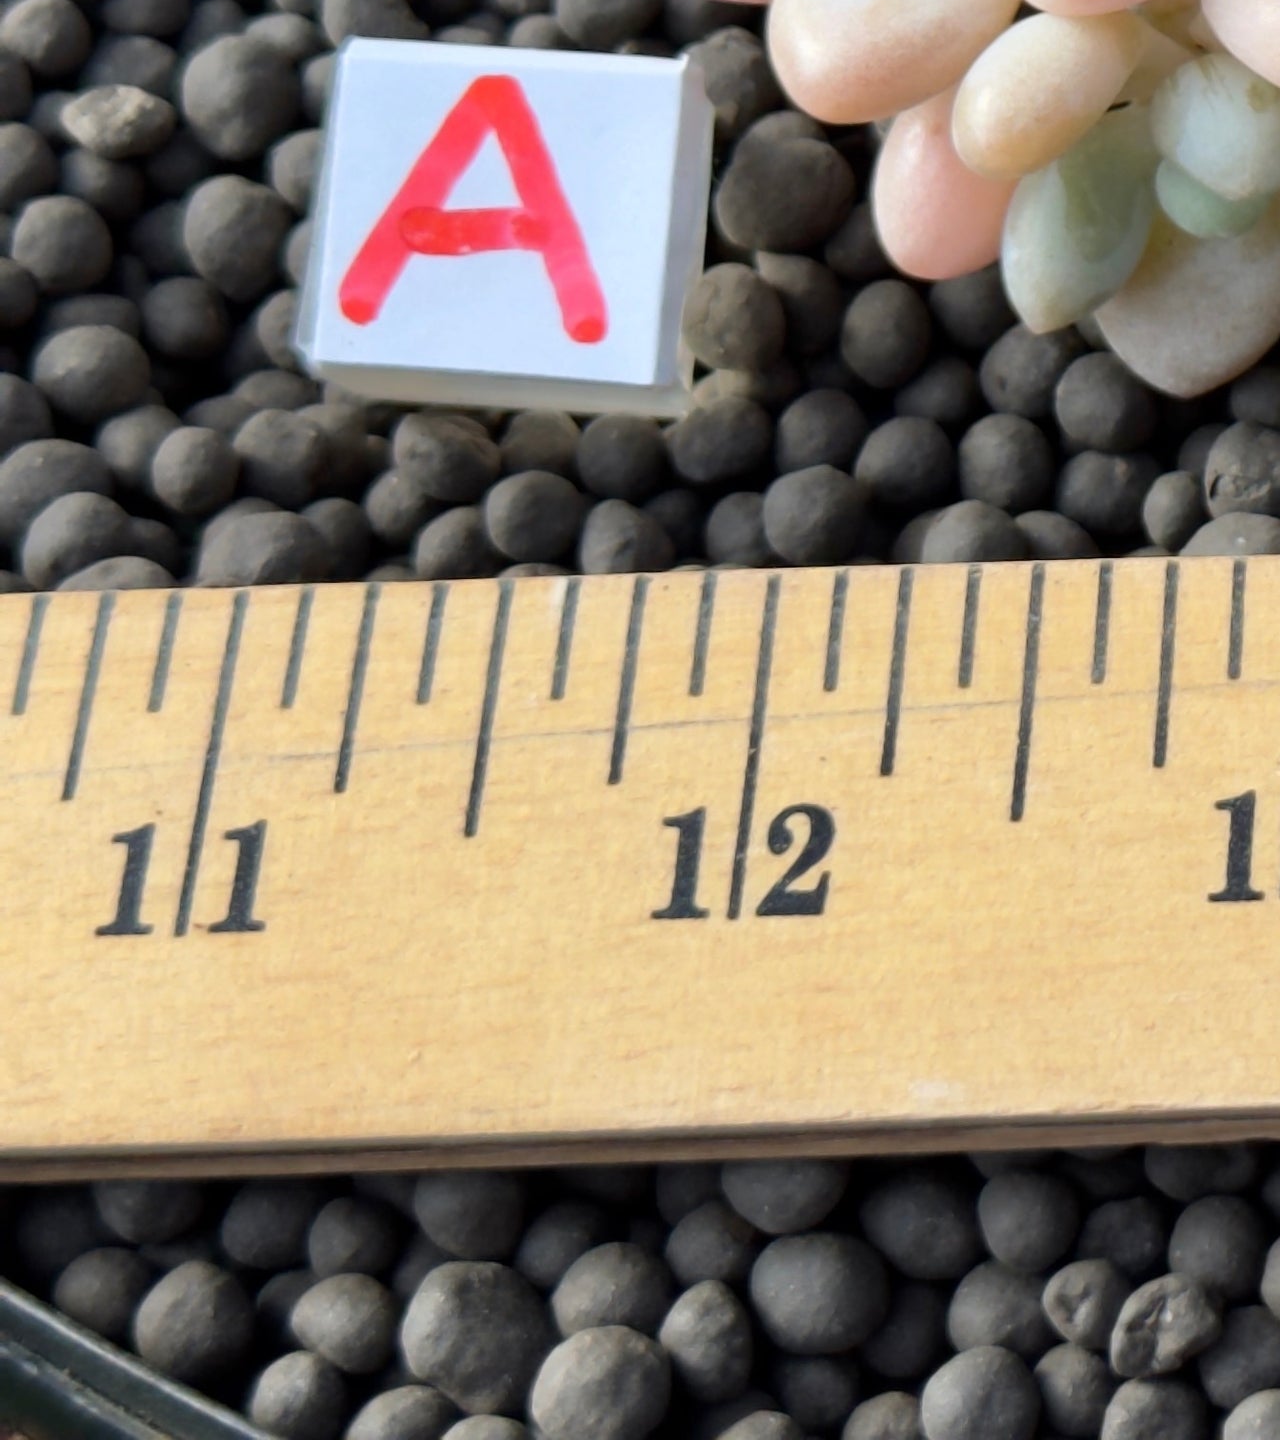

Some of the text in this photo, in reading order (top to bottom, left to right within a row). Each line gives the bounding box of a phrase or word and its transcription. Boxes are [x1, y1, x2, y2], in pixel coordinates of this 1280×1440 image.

[338, 73, 609, 345] A
[94, 818, 268, 937] 11
[650, 802, 837, 921] 12
